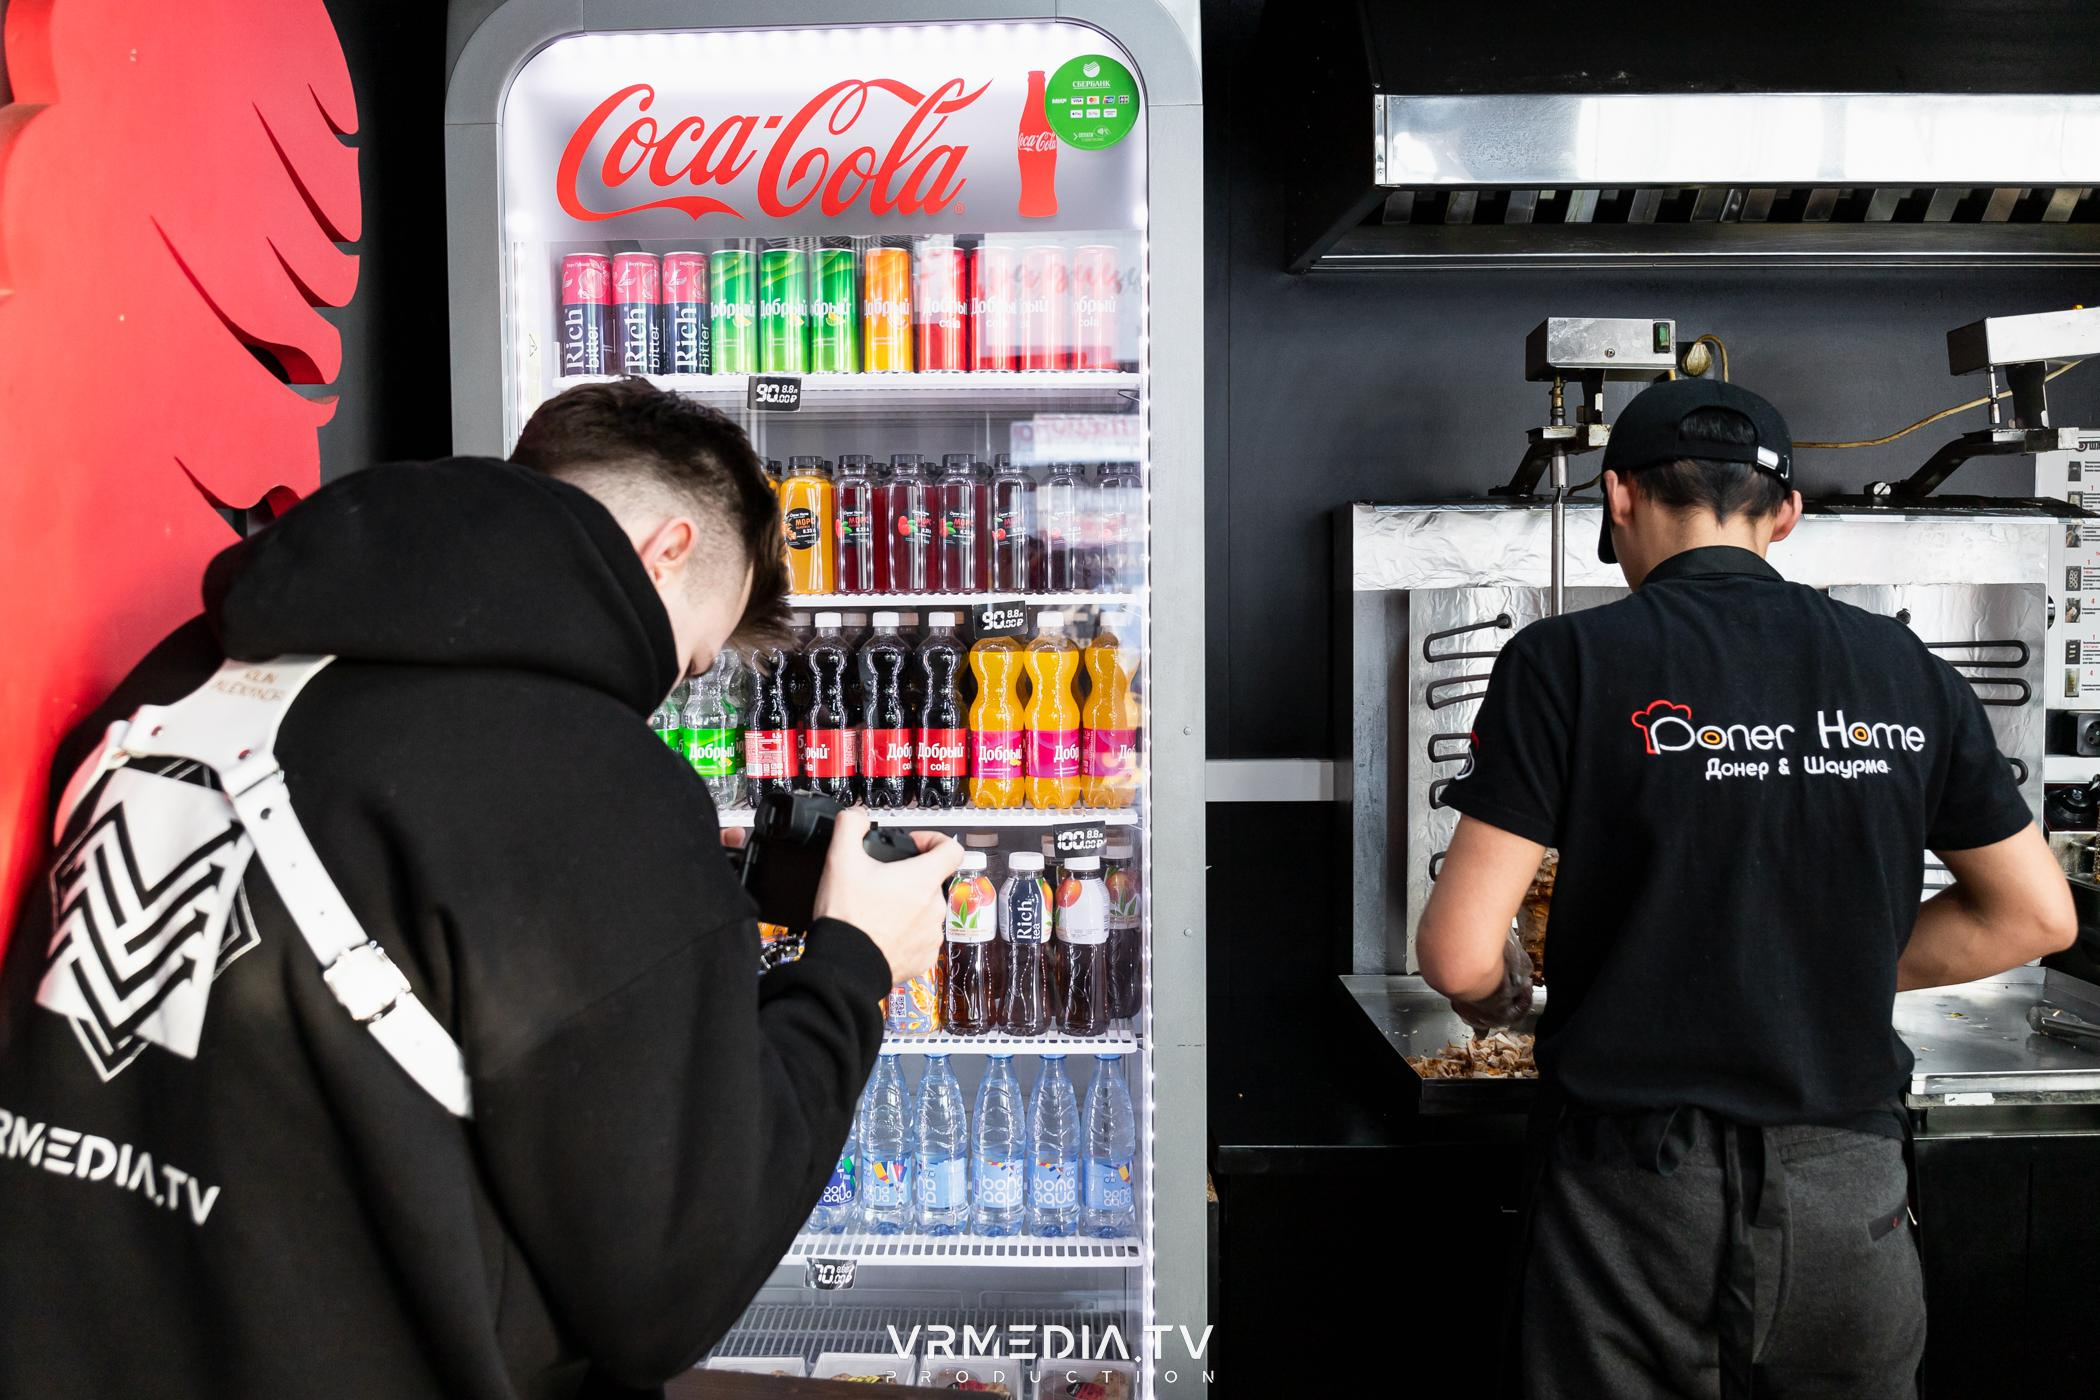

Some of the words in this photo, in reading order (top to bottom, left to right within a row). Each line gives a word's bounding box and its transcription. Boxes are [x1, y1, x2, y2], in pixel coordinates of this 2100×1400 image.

[1072, 80, 1111, 88] СБЕРБАНК
[556, 77, 994, 221] Coca-Cola
[565, 308, 585, 368] Rich
[586, 323, 600, 369] bitter
[624, 306, 648, 368] Rich
[648, 324, 661, 368] bitter
[674, 306, 698, 367] Rich
[699, 323, 710, 368] bitter
[689, 742, 735, 761] Добрый
[806, 744, 830, 761] рый
[918, 742, 964, 761] Добрый
[1650, 716, 1795, 755] Doner
[1817, 709, 1926, 752] Home
[930, 762, 951, 771] cola
[1705, 757, 1770, 781] Донер
[1778, 757, 1791, 776] &
[1803, 756, 1889, 779] Шаурма
[1016, 900, 1033, 940] Rich
[1032, 923, 1041, 940] tea
